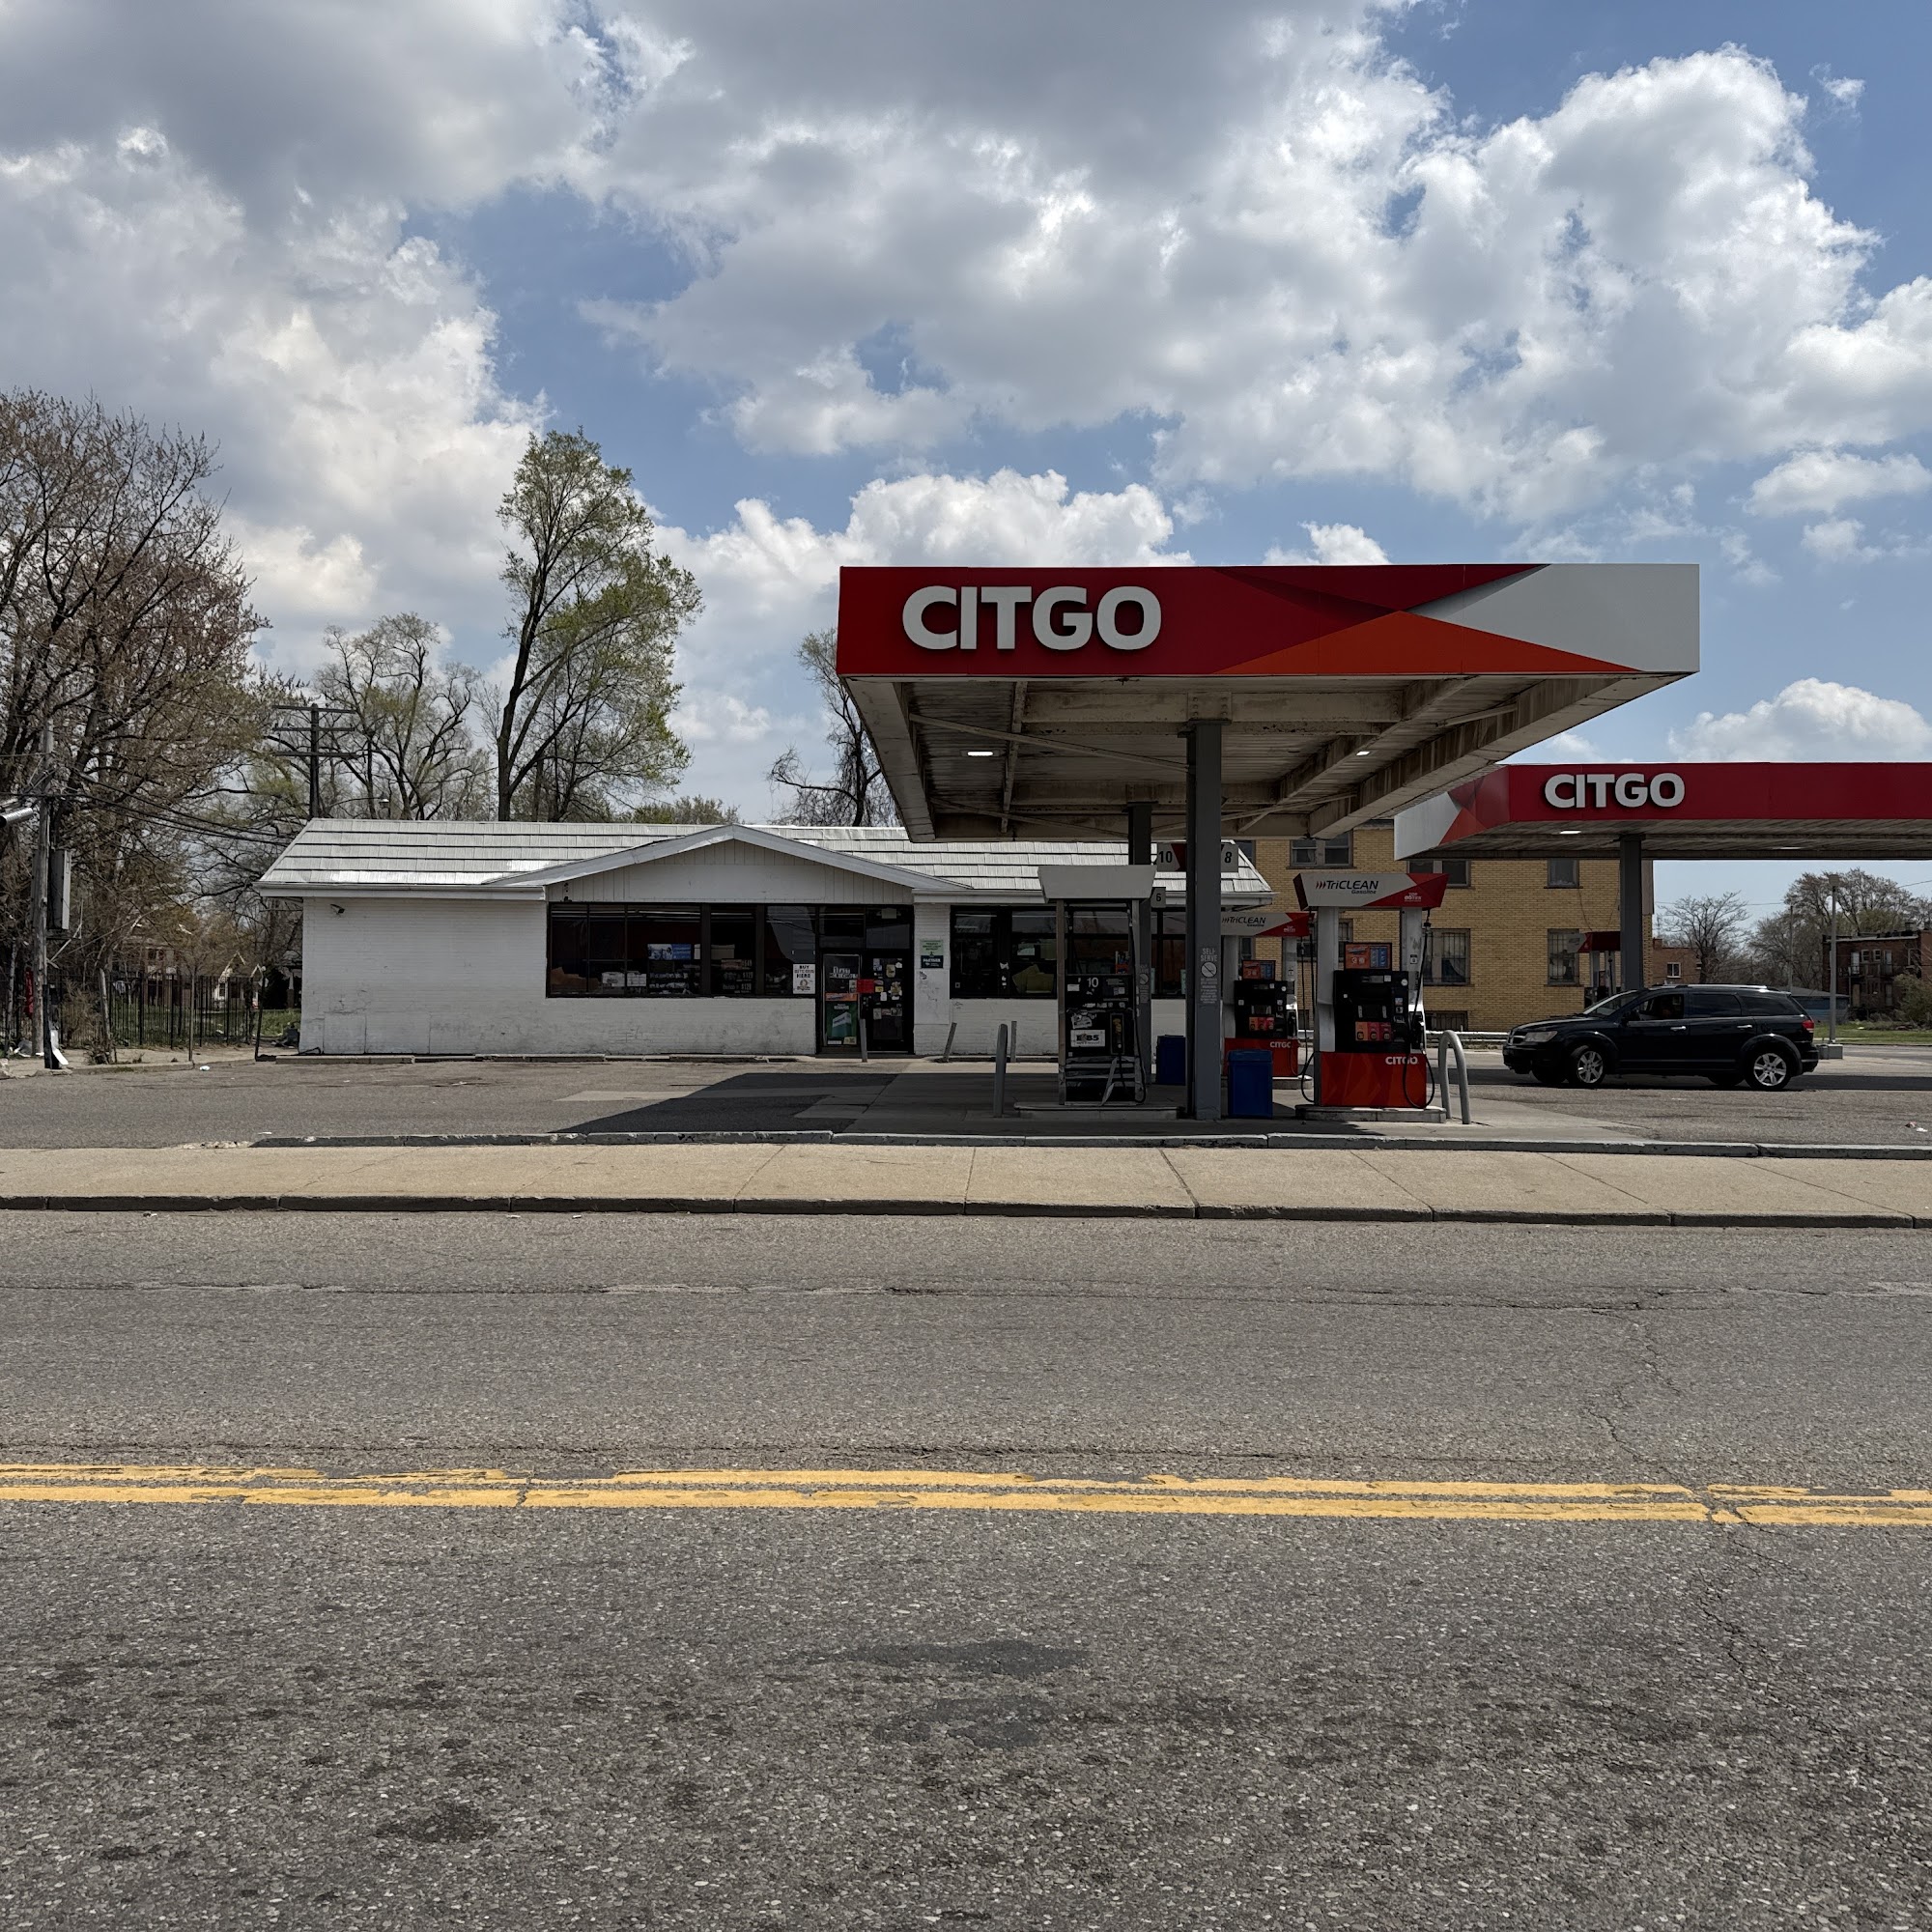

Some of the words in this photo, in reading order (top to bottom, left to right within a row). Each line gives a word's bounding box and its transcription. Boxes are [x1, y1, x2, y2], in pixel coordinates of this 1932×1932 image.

[902, 585, 1161, 650] CITGO
[1545, 773, 1685, 808] CITGO
[1159, 851, 1173, 863] 10
[1224, 851, 1233, 864] 8
[1326, 880, 1379, 890] TriCLEAN
[1155, 893, 1162, 902] 6
[1087, 977, 1099, 988] 10
